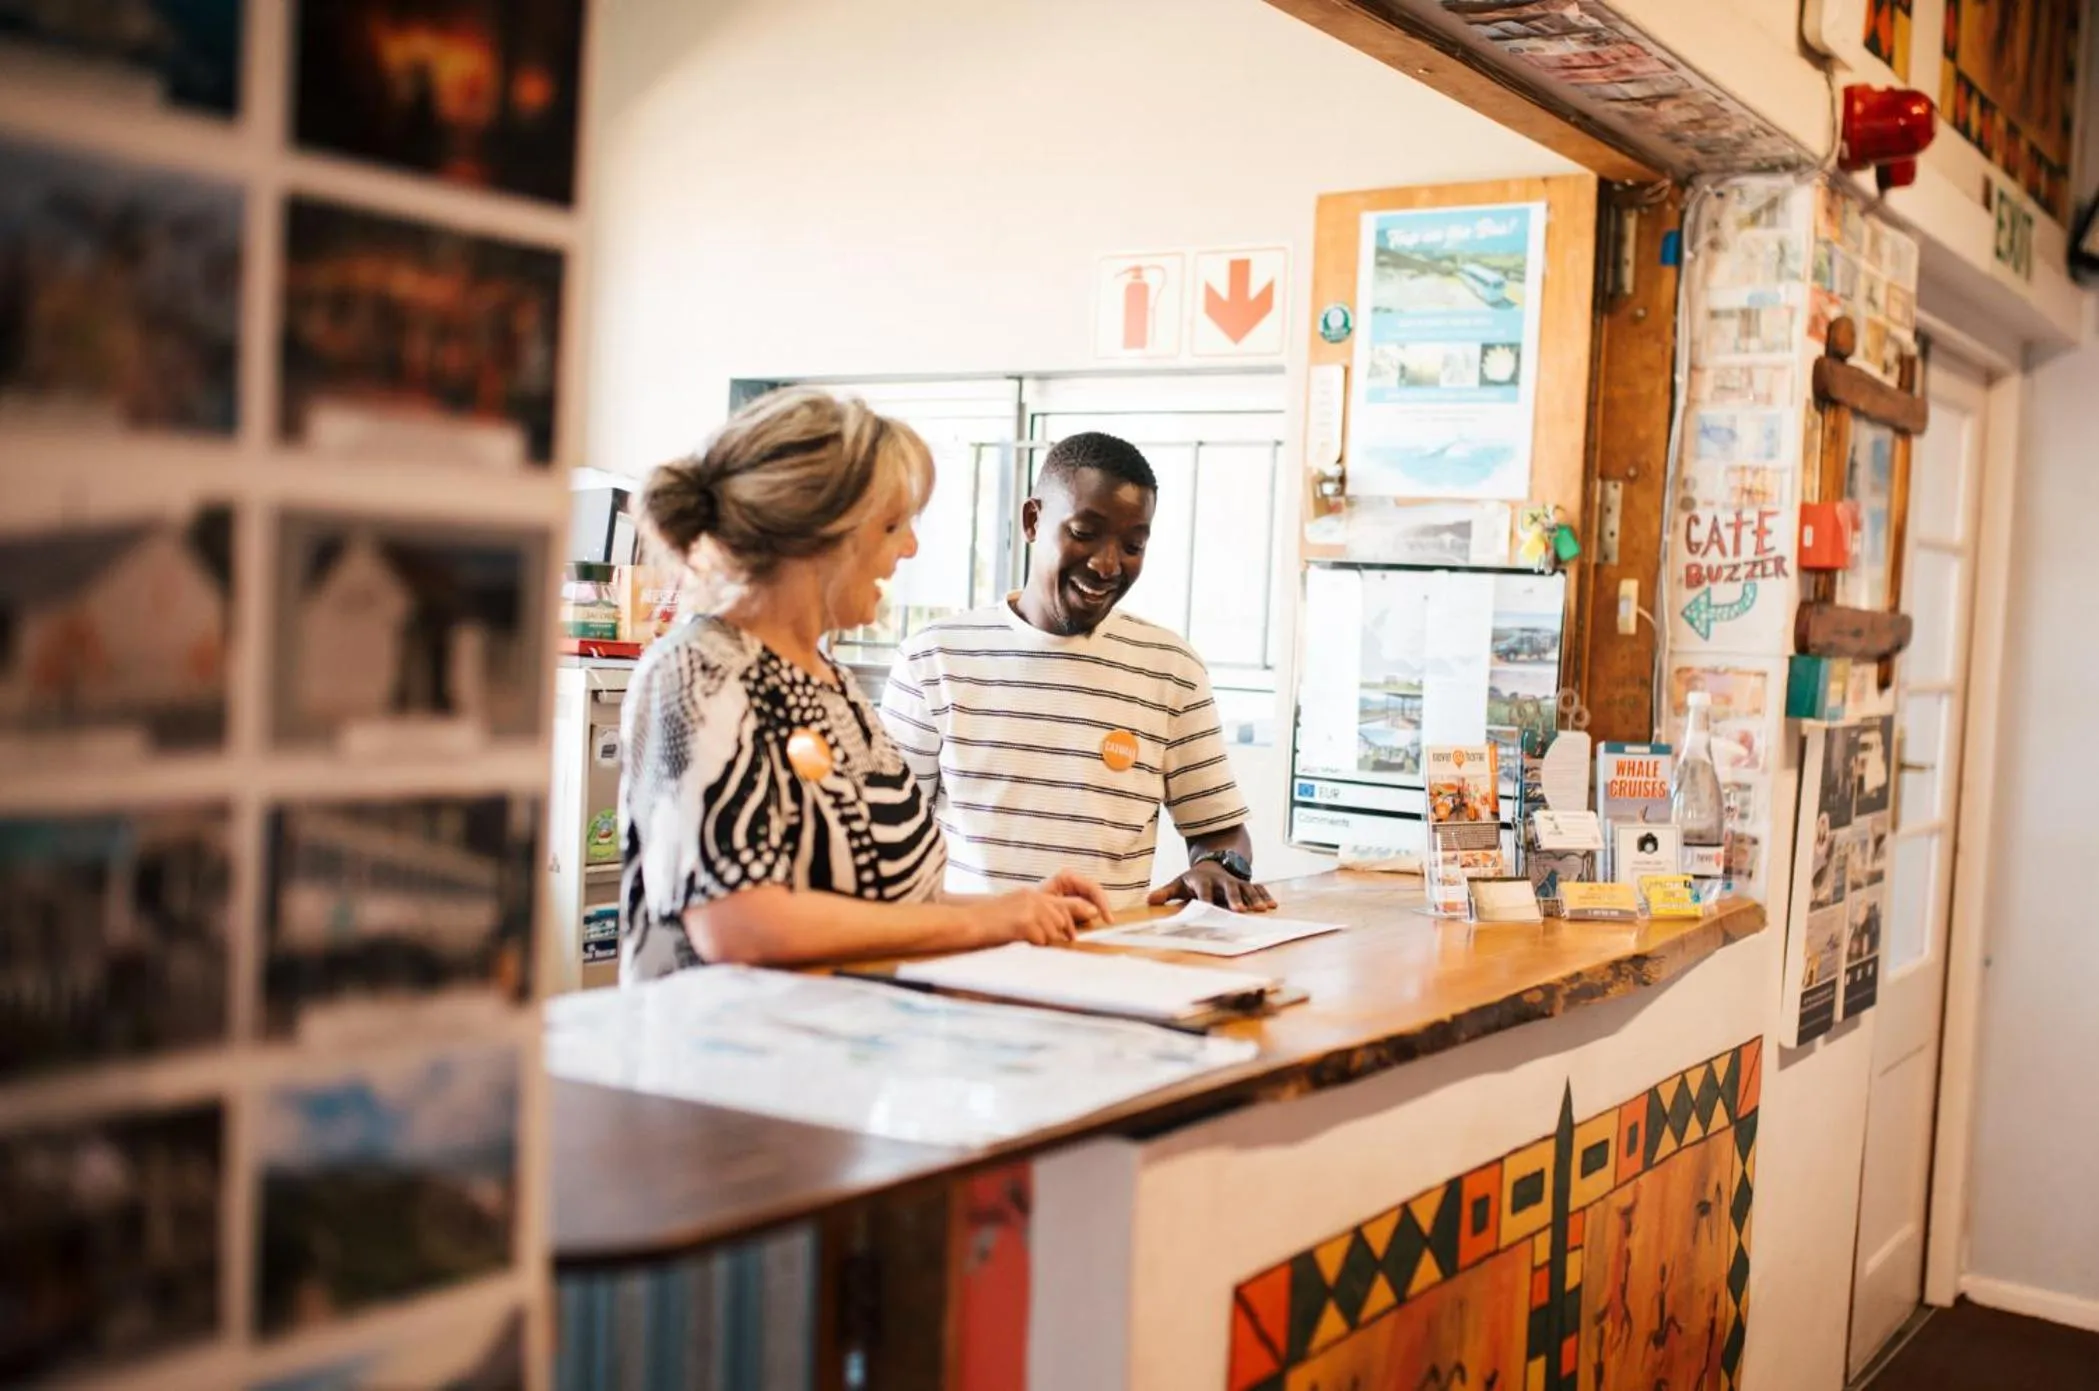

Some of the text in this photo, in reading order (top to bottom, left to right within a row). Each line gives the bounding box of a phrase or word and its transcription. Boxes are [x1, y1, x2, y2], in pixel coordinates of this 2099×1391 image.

[1686, 556, 1788, 589] BUZZER
[1616, 760, 1660, 777] WHALE
[1318, 787, 1340, 799] EUR
[1609, 780, 1667, 798] CRUISES
